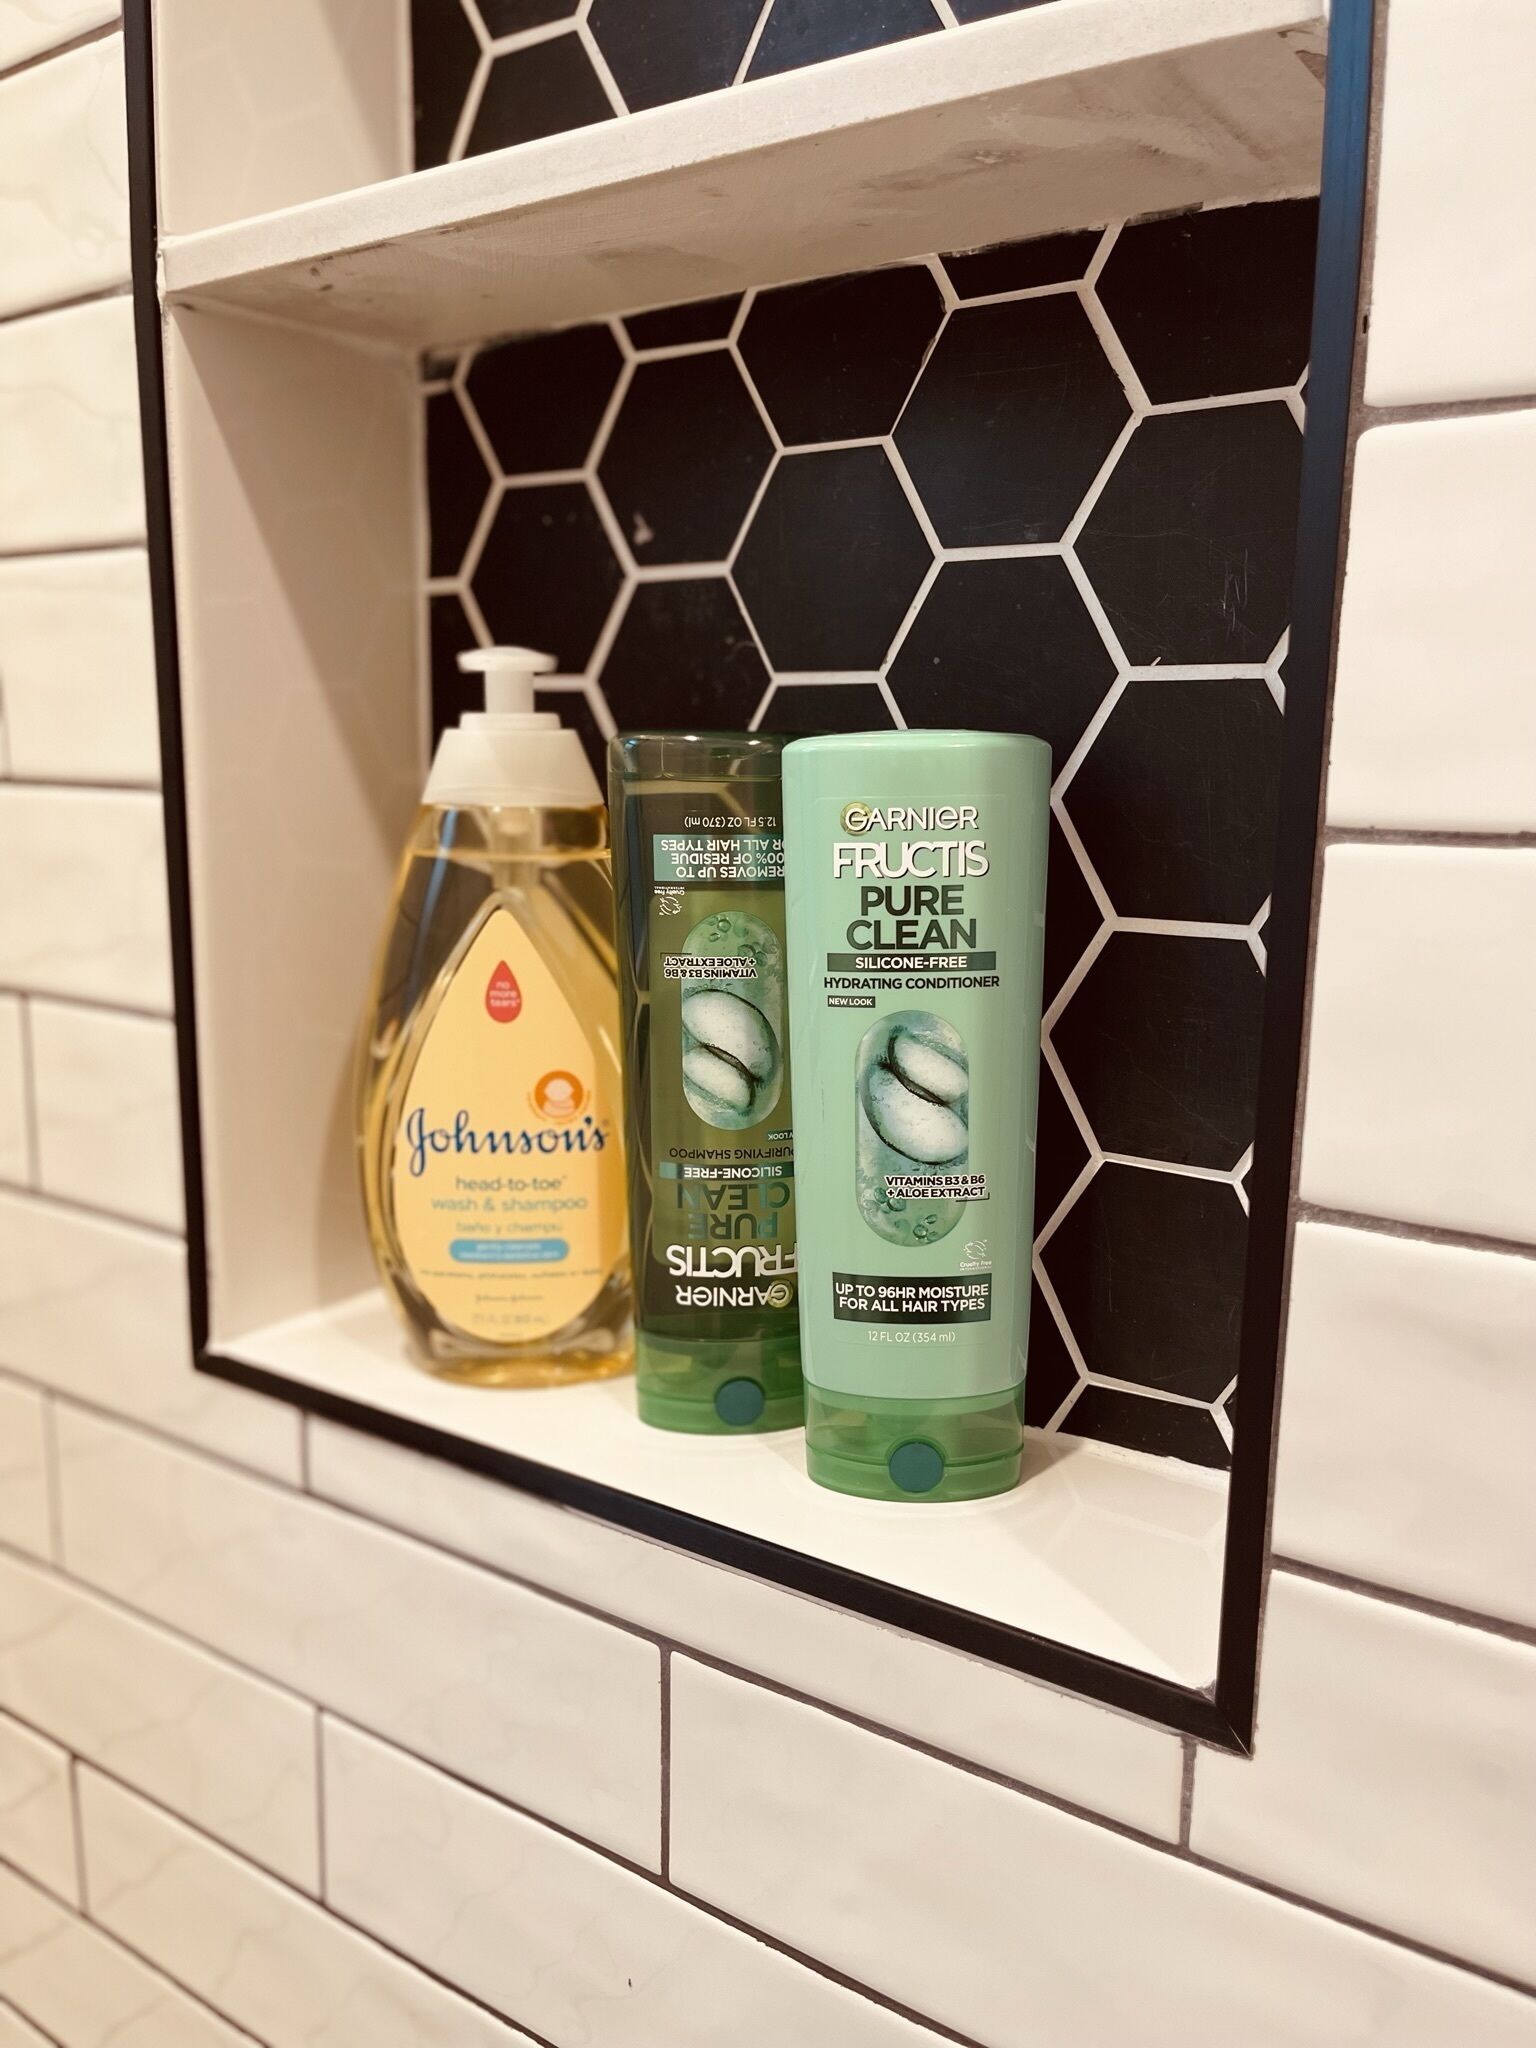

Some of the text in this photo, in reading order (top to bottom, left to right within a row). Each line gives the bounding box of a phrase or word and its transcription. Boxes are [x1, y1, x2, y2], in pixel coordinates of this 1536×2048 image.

[702, 816, 726, 828] (370
[727, 816, 742, 828] OZ
[743, 817, 757, 827] FL
[758, 816, 777, 827] 12.5
[844, 805, 979, 832] GARNIER
[661, 839, 703, 851] TYPES
[706, 839, 740, 851] HAIR
[743, 839, 769, 850] ALL
[671, 852, 785, 865] 00% OF RESIDUE
[833, 840, 990, 879] FRUCTIS
[676, 866, 785, 879] REMOVES UP TO
[860, 884, 965, 916] PURE
[846, 918, 977, 950] CLEAN
[664, 957, 715, 967] EXTRACT
[717, 957, 747, 967] ALOE
[855, 956, 968, 970] SILICONE-FREE
[665, 968, 758, 978] VITAMINS B3 & B6
[824, 976, 1000, 990] HYDRATING CONDITIONER
[828, 997, 873, 1006] NEW LOOK
[406, 1107, 608, 1178] Johnson's
[767, 1132, 789, 1141] LOOK
[669, 1147, 732, 1159] SHAMPOO
[683, 1165, 783, 1179] SILICONE-FREE
[885, 1174, 985, 1186] VITAMINS B3 & B6
[677, 1181, 791, 1211] CLEAN
[896, 1188, 929, 1198] ALOE
[931, 1186, 985, 1198] EXTRACT
[431, 1197, 478, 1211] wash
[502, 1197, 588, 1213] shampoo
[688, 1212, 778, 1240] PURE
[665, 1244, 799, 1279] FRUCTIS
[675, 1284, 790, 1308] GARNIER
[835, 1282, 989, 1299] UP TO 96HR MOISTURE
[839, 1296, 985, 1313] FOR ALL HAIR TYPES
[867, 1330, 956, 1344] 12 FL OZ (354 ml)
